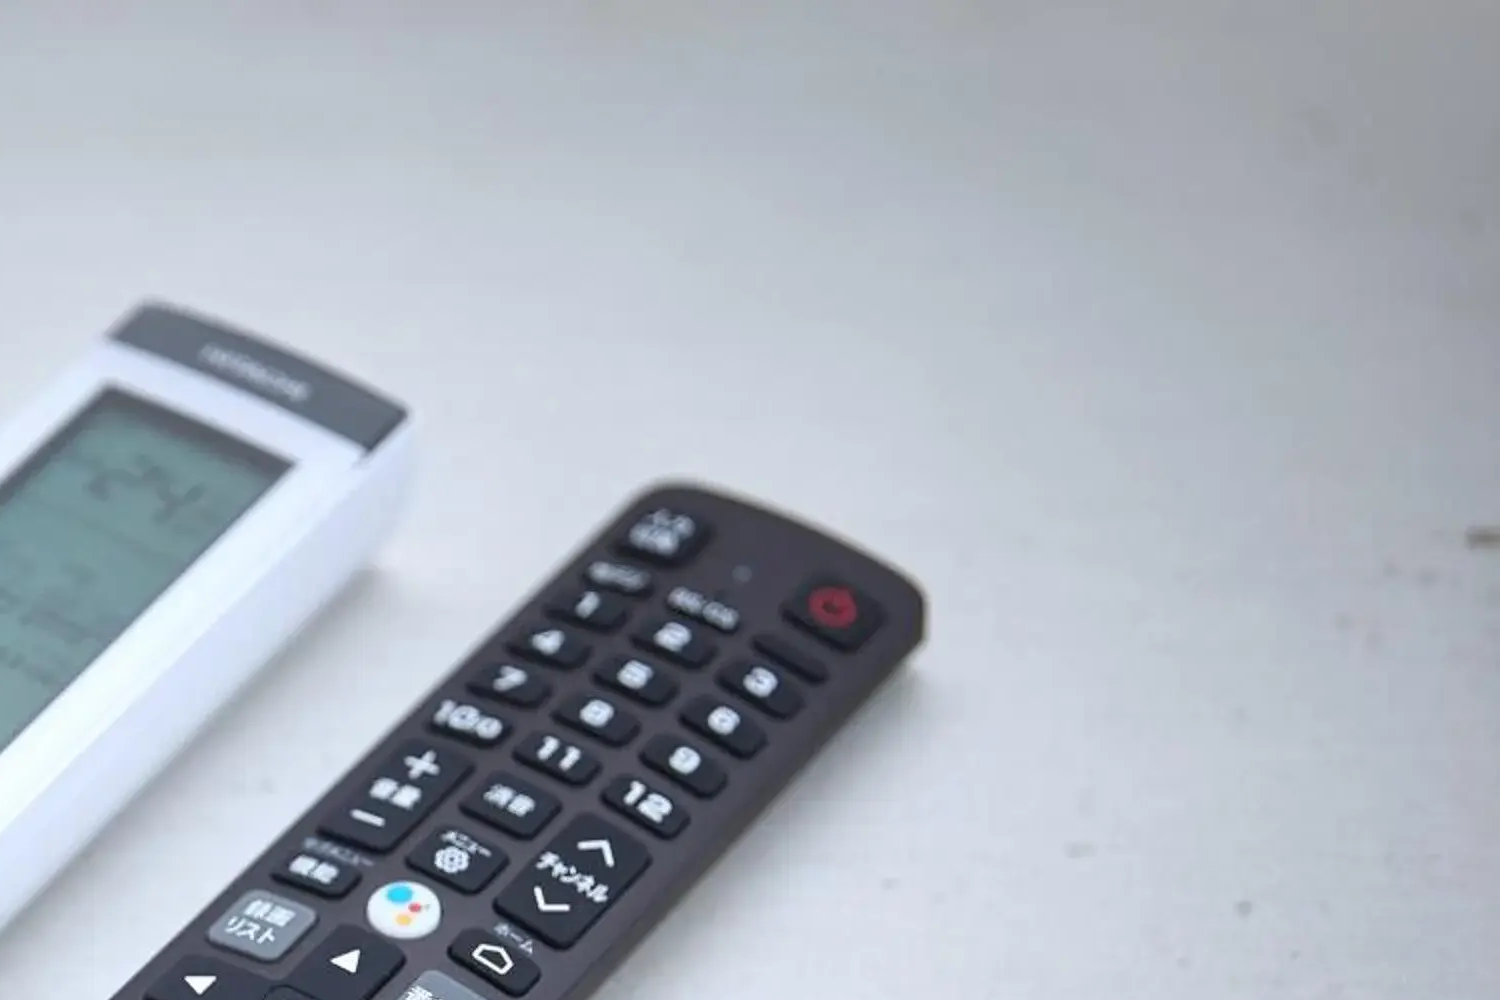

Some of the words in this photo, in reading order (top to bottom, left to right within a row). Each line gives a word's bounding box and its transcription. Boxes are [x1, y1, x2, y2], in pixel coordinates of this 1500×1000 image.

[537, 736, 581, 770] 11
[623, 780, 672, 822] 12
[536, 852, 608, 902] チャンネル
[225, 916, 275, 943] リスト
